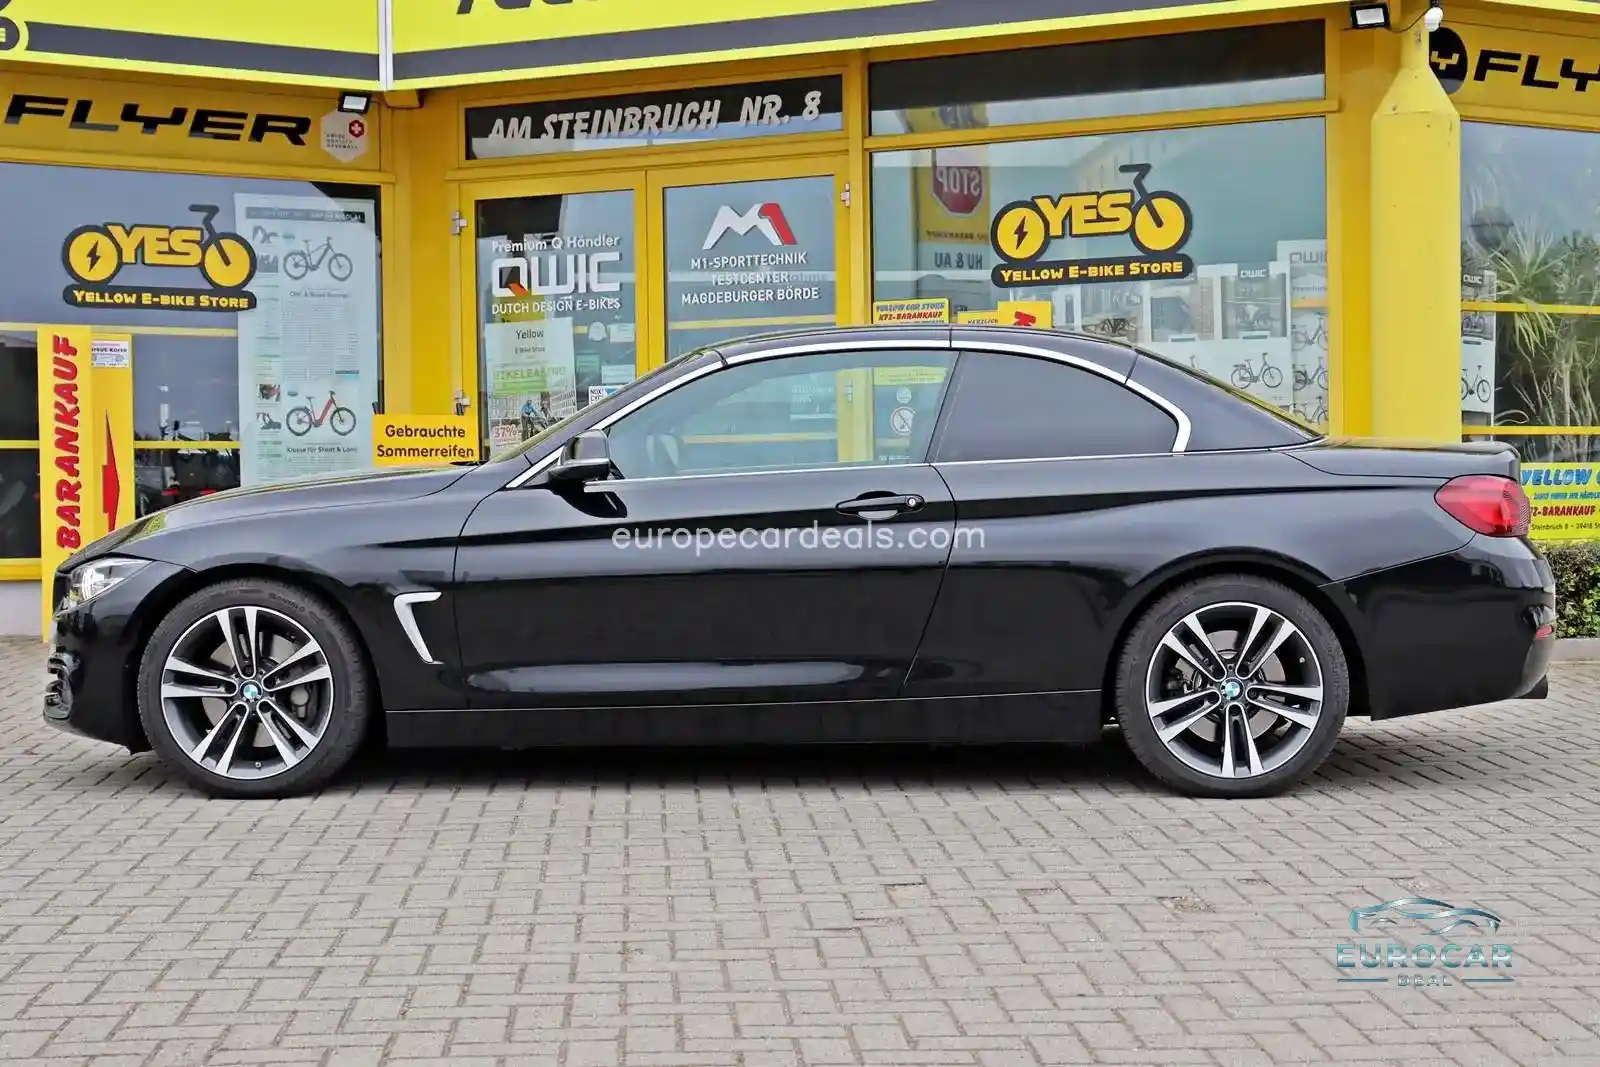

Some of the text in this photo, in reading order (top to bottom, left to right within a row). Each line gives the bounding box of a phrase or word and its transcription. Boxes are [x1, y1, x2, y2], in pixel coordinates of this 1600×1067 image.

[4, 94, 312, 146] FLYER
[488, 90, 823, 142] AM STEINBRUCH NR. 8
[1033, 192, 1132, 238] YES
[107, 224, 203, 266] YES
[491, 235, 620, 253] Premium Q Händler
[690, 252, 807, 270] M1-SPORTTECHNIK
[491, 252, 621, 299] QWIC
[711, 272, 789, 286] TESTCENTER
[1000, 268, 1064, 283] YELLOW
[1069, 264, 1125, 280] E-BIKE
[1129, 260, 1183, 277] STORE
[73, 289, 249, 309] YELLOW E-BIKE STORE
[681, 285, 820, 306] MAGDEBURGER BÖRDE
[491, 297, 621, 316] DUTCH DESIGN E-BIKES
[516, 329, 544, 340] Yellow
[52, 334, 82, 549] BARANKAUF
[385, 424, 466, 439] Gebrauchte
[376, 443, 475, 458] Sommerreifen
[1520, 469, 1593, 486] YELLOW
